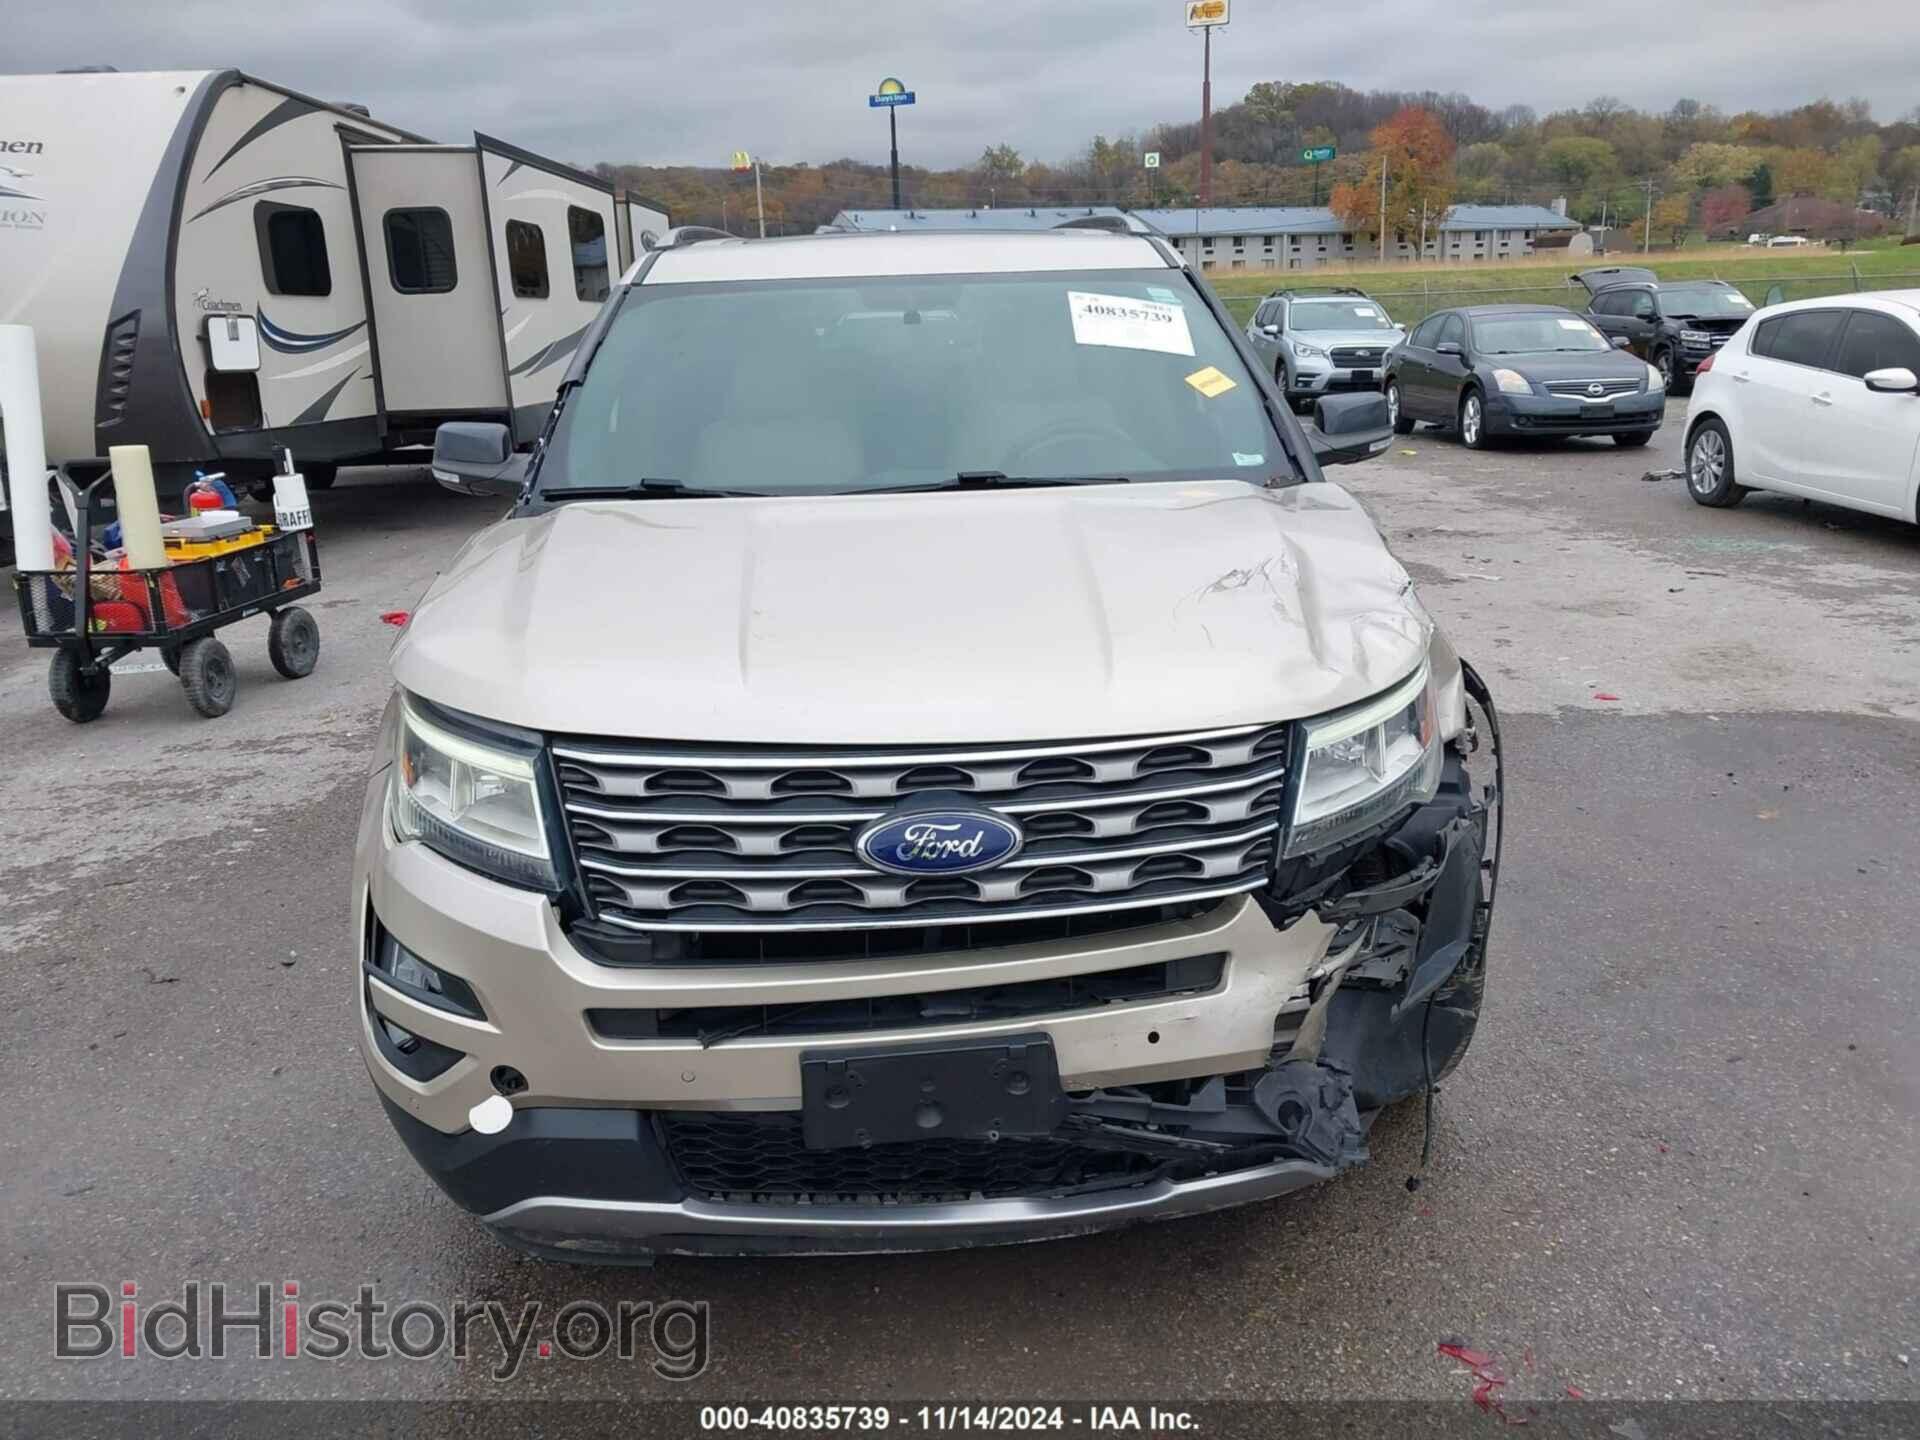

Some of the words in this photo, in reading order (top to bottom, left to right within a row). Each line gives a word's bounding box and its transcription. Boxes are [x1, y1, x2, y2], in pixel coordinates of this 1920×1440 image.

[0, 210, 48, 224] ION
[1082, 303, 1173, 323] 40835739
[896, 823, 984, 861] Ford
